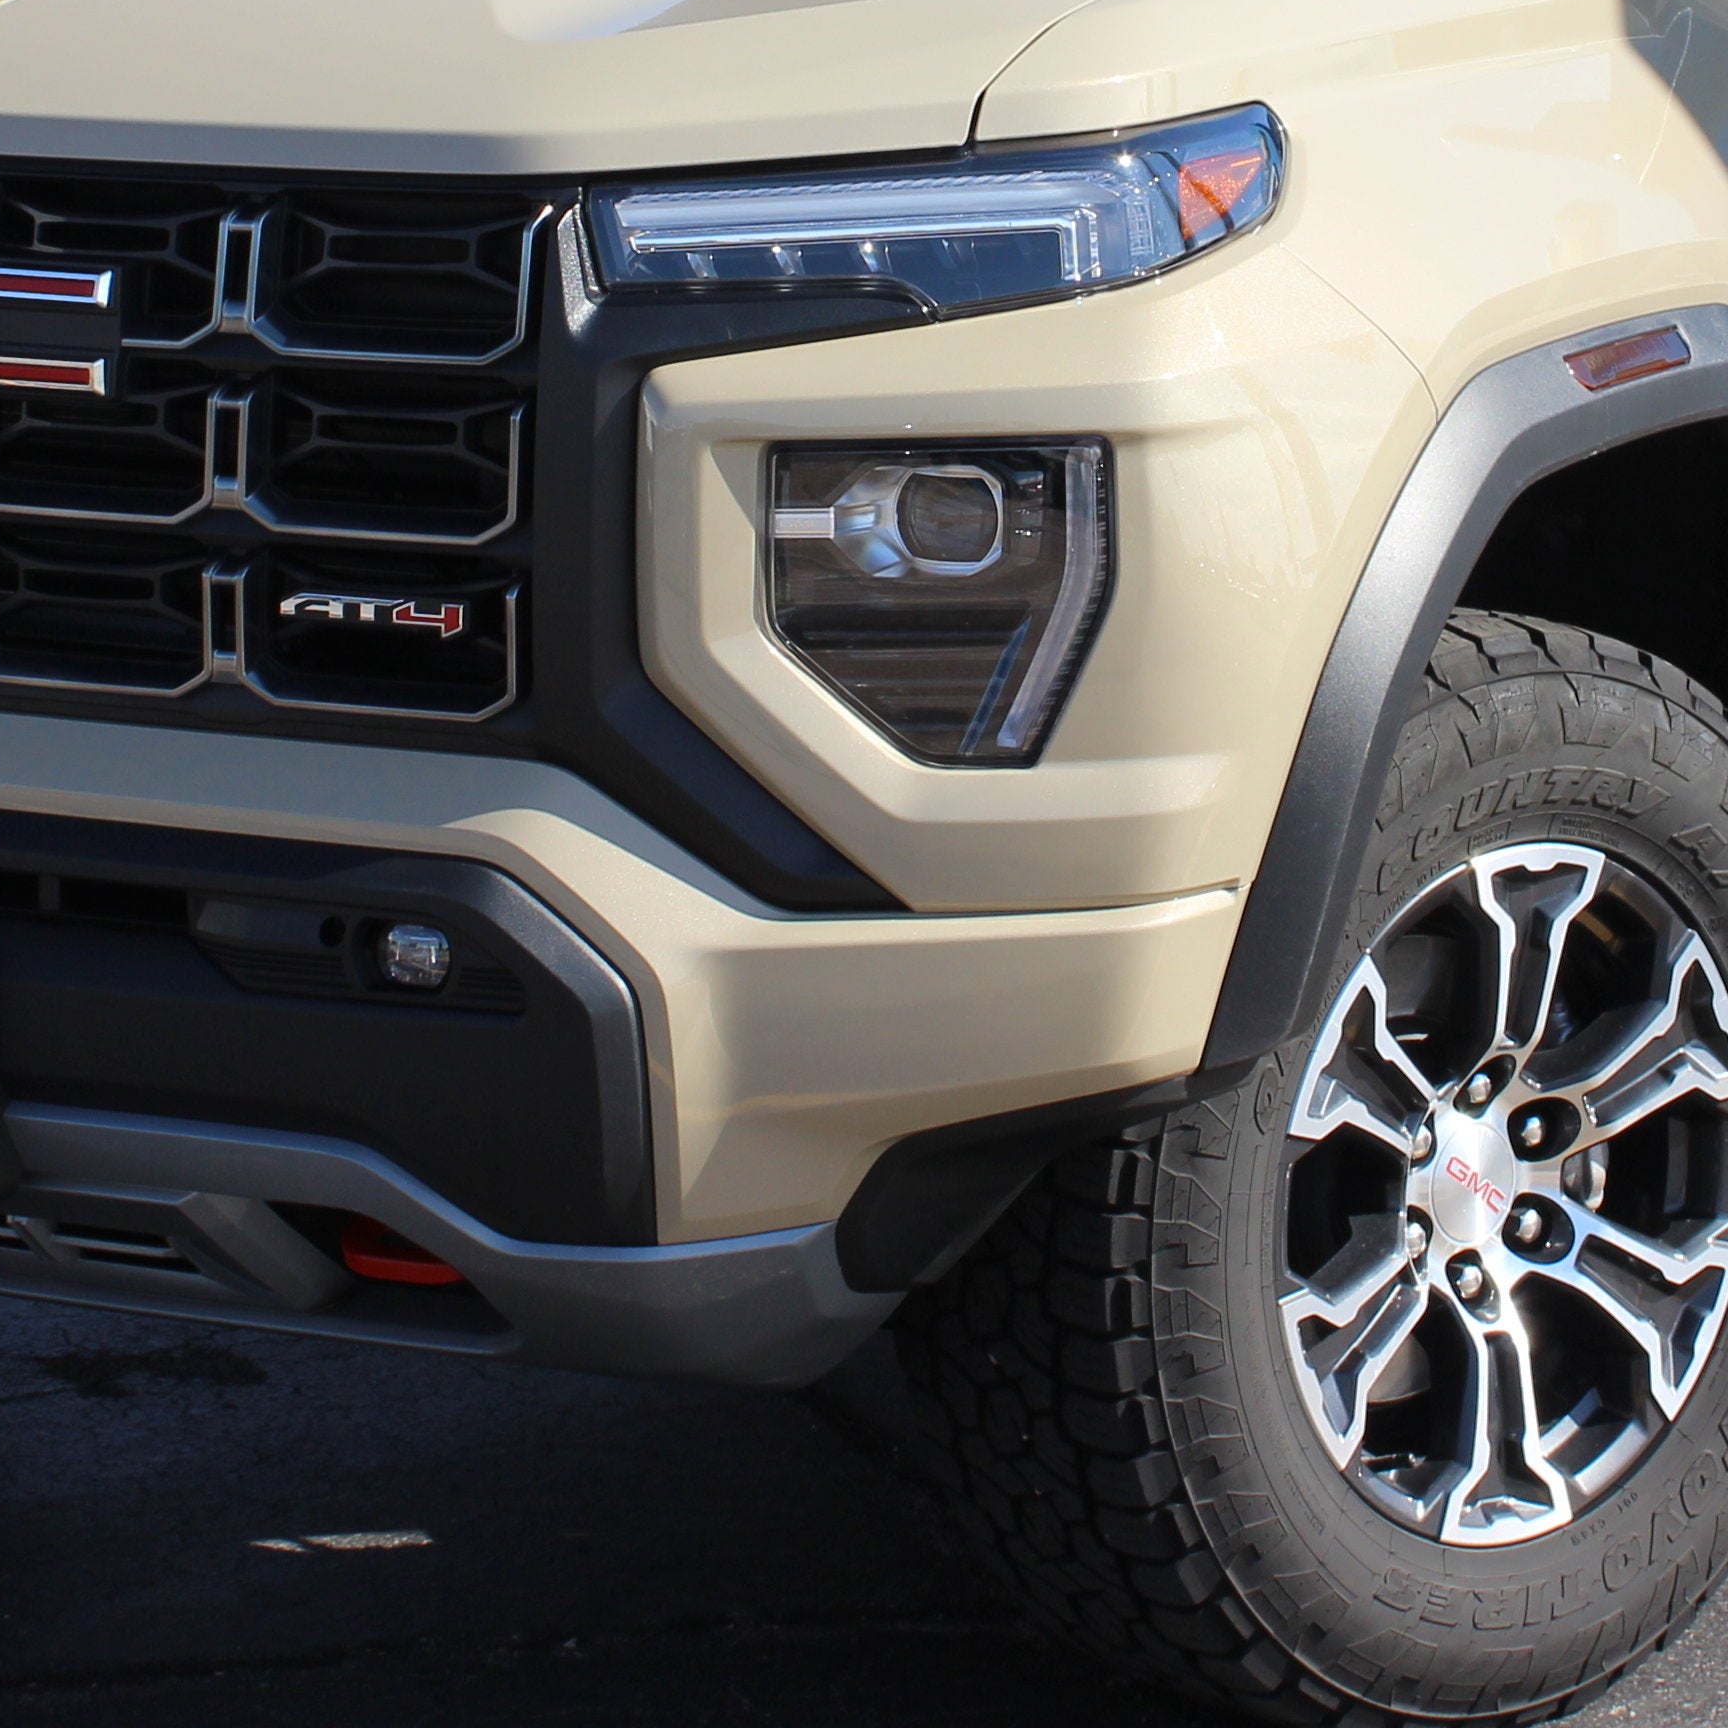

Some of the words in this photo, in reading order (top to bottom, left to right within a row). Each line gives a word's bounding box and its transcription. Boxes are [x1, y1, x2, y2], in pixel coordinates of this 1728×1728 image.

[280, 592, 465, 639] AT4
[1375, 765, 1670, 897] COUNTRY
[1445, 1155, 1507, 1215] GMC
